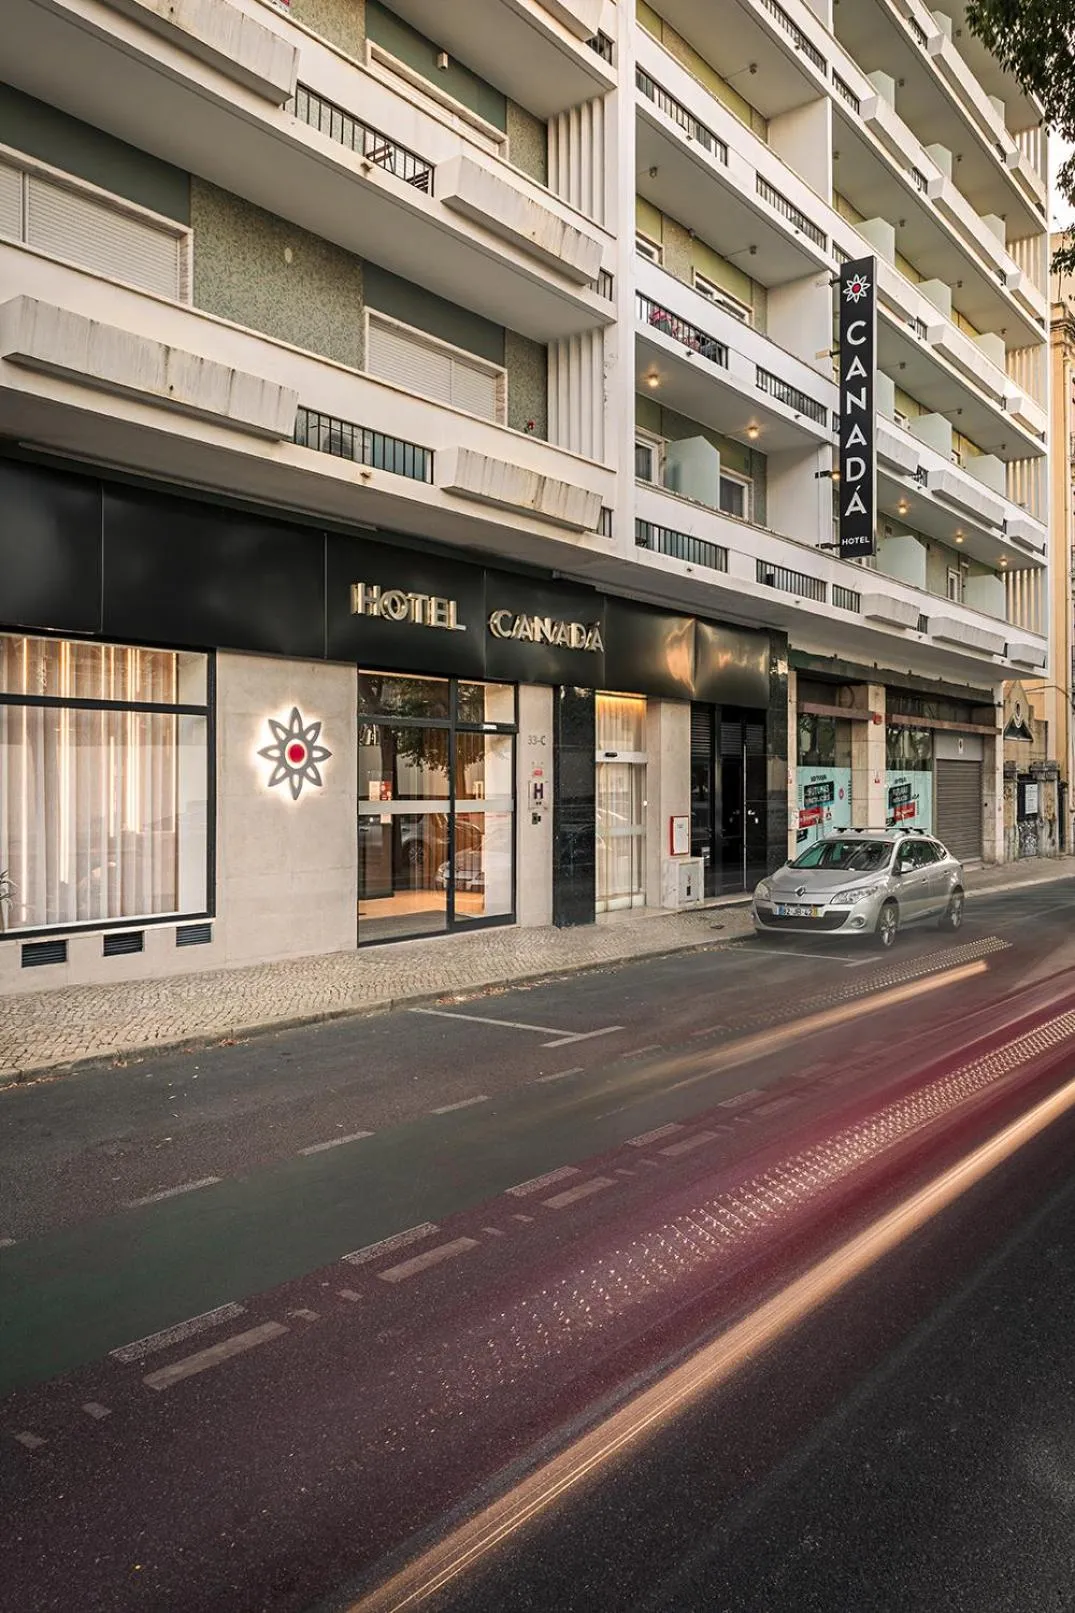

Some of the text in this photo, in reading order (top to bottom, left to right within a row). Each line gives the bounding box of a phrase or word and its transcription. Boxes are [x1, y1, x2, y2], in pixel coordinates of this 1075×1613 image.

[845, 320, 868, 517] CANADÁ
[841, 536, 871, 546] HOTEL
[351, 582, 605, 653] HOTEL CANADÁ
[528, 735, 546, 745] 33-C
[534, 783, 543, 799] H
